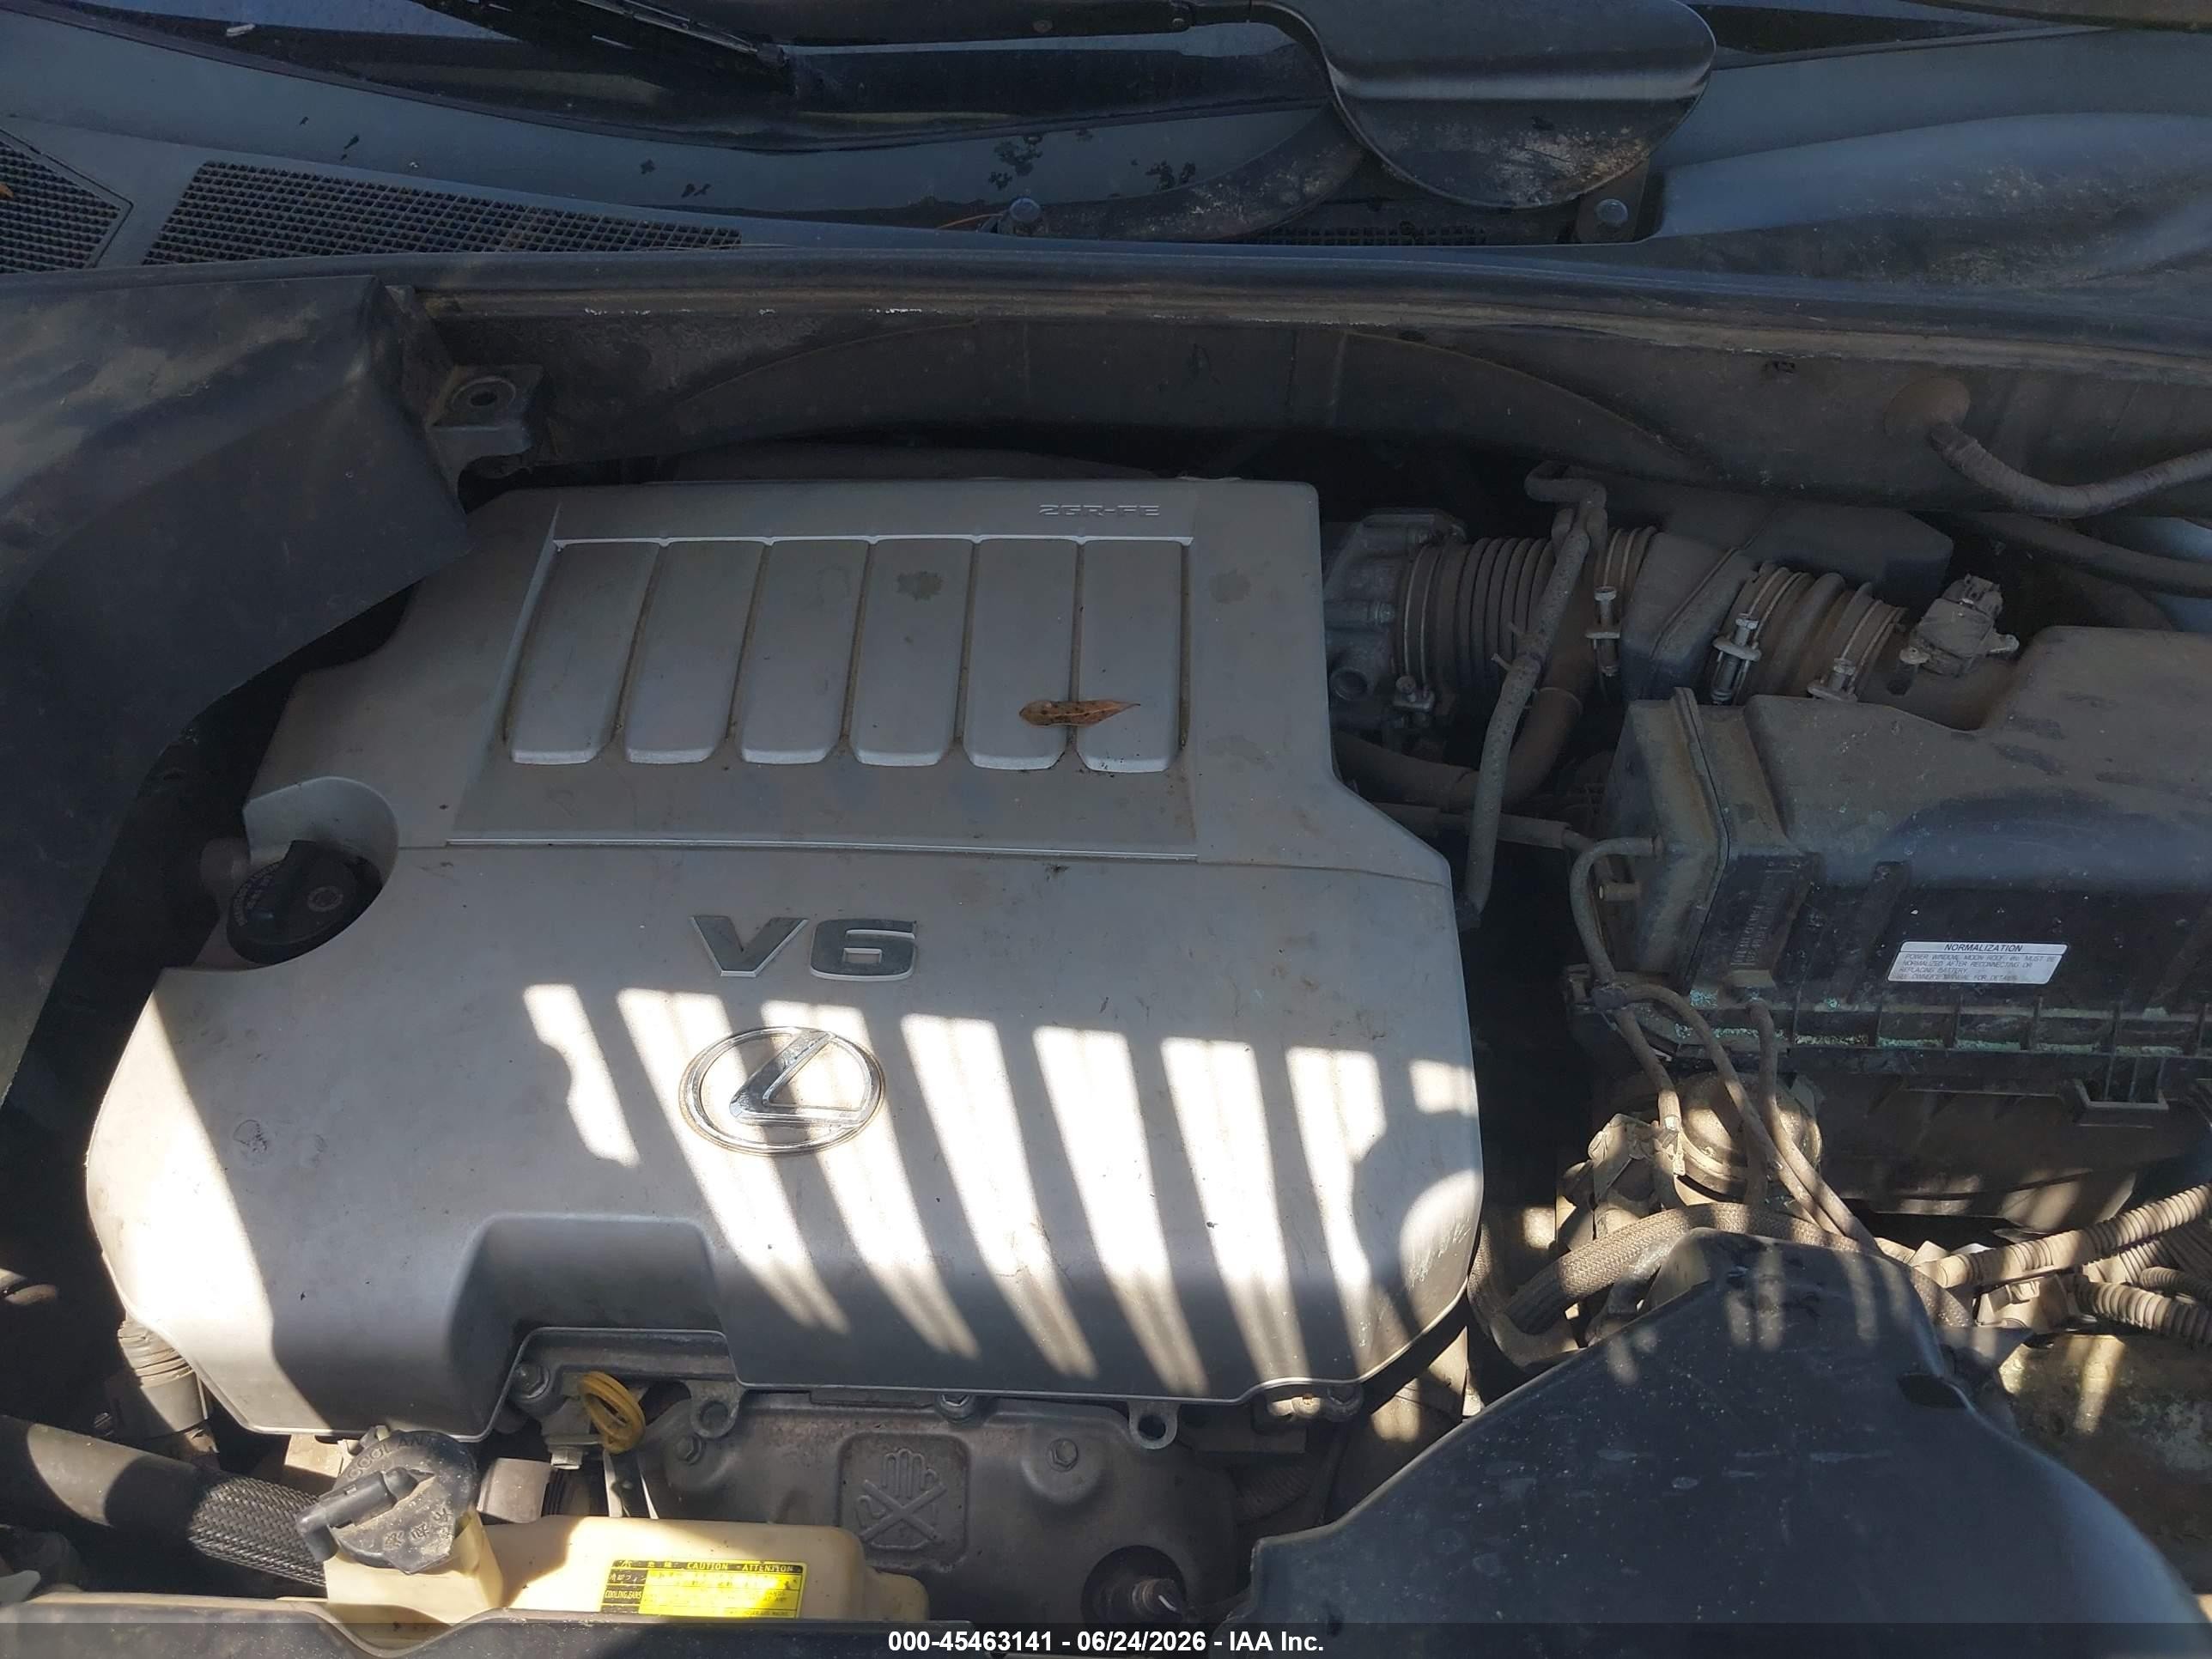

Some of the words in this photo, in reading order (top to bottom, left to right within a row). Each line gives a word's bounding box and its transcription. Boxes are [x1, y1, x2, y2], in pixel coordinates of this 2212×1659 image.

[1038, 503, 1160, 517] 2GR-FE
[689, 915, 917, 981] V6
[1944, 944, 2023, 952] NORMALIZATION
[348, 1434, 433, 1480] COOLANT
[687, 1562, 728, 1571] CAUTION
[742, 1564, 793, 1572] ATTENTION
